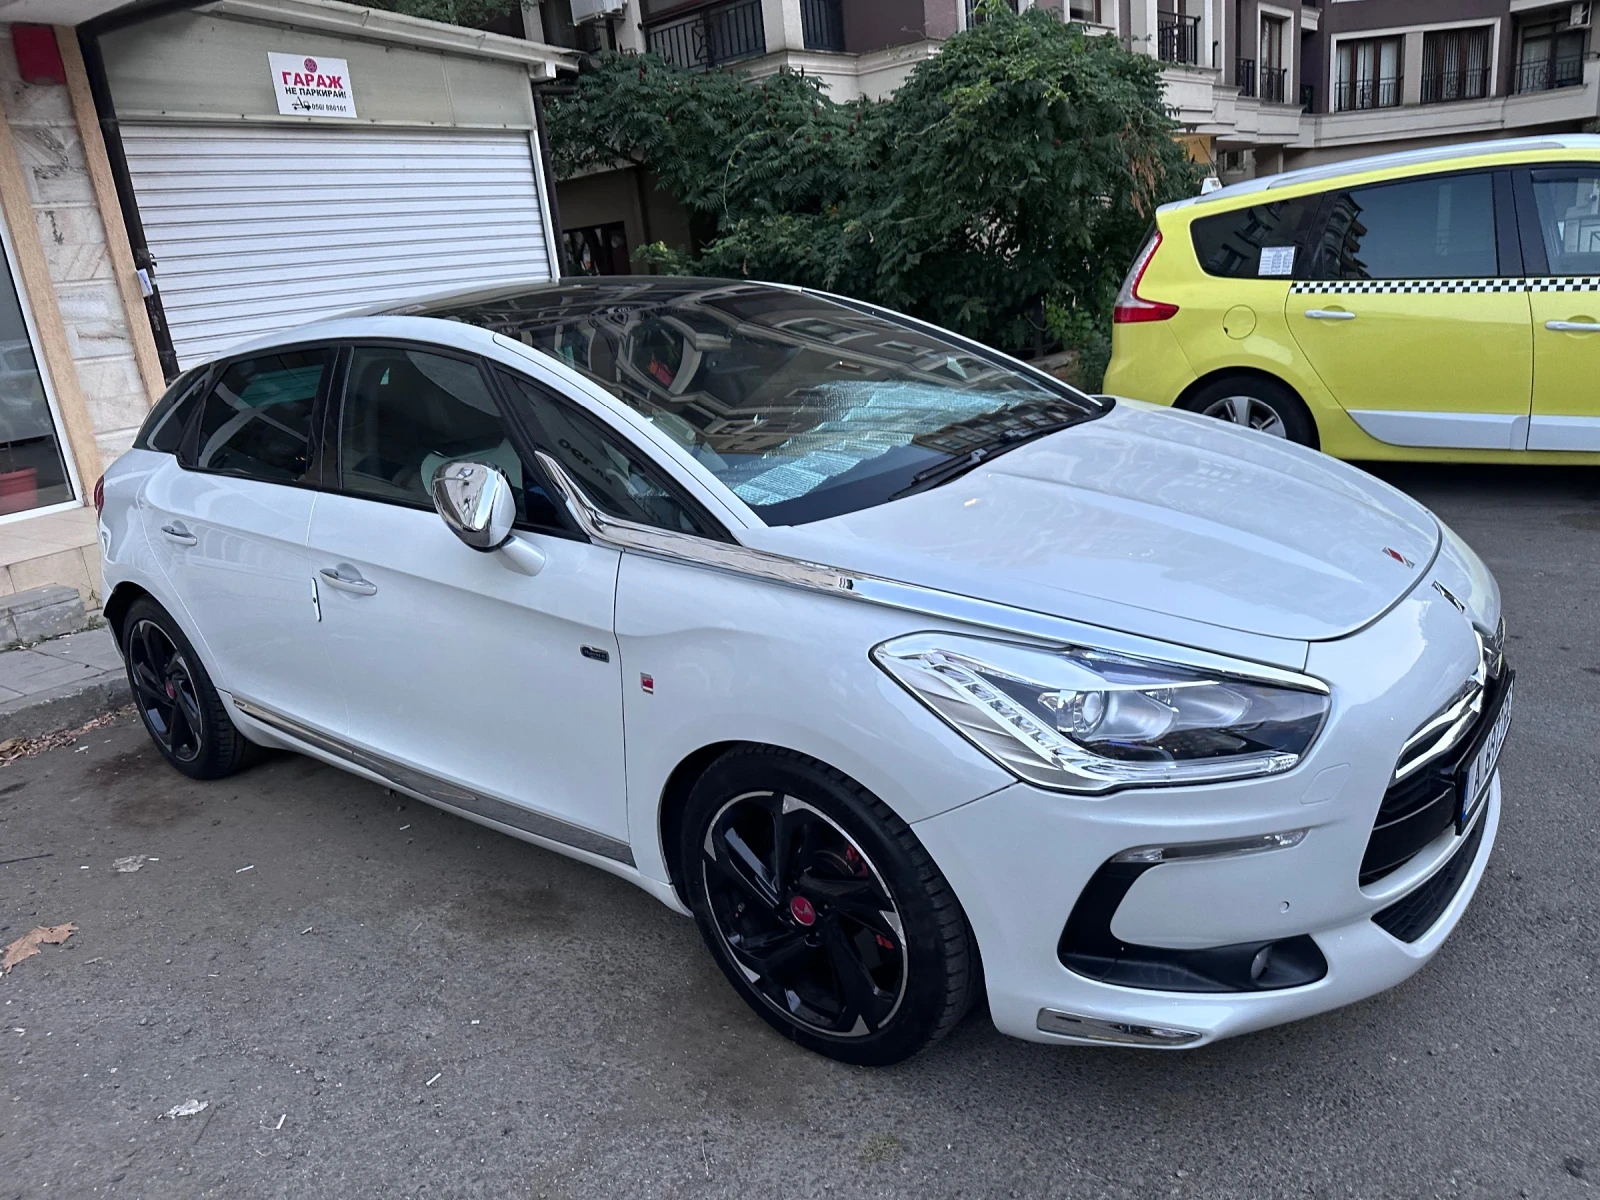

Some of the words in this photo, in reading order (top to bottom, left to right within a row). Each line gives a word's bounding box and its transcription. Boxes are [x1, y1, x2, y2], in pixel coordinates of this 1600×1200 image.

[282, 71, 343, 89] ГАРАЖ
[285, 87, 297, 95] НЕ
[299, 88, 347, 99] ПАРКИРАЙ!
